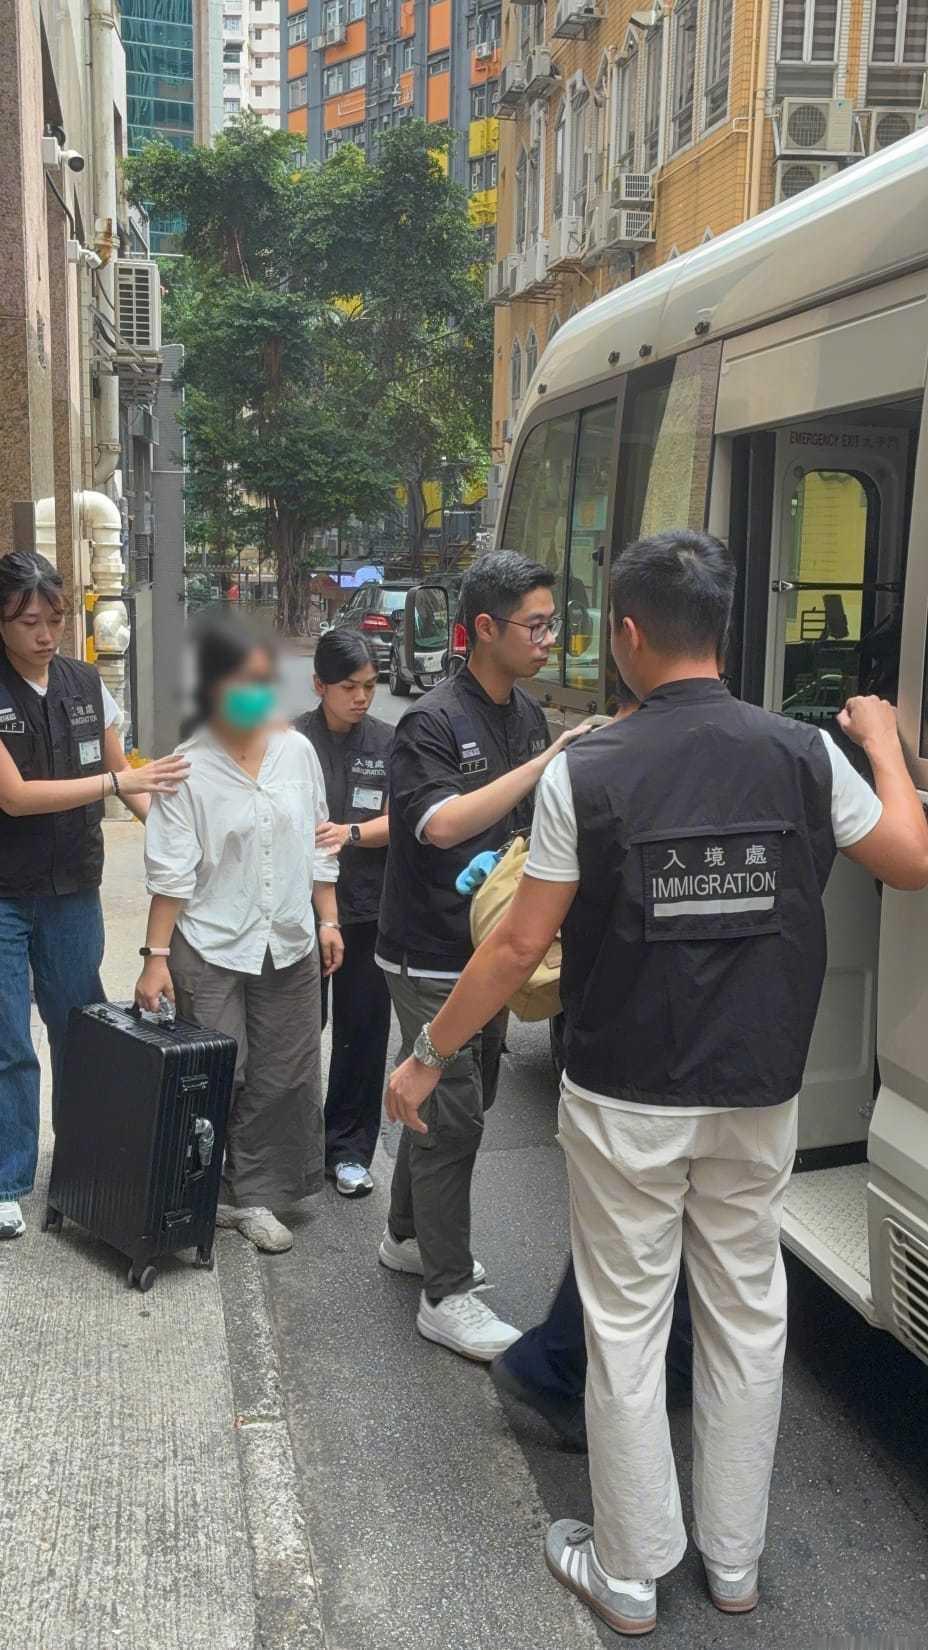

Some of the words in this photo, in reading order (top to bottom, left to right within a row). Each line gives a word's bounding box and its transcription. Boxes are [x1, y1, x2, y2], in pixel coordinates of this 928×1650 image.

[789, 431, 839, 447] EMERGENCY
[841, 434, 860, 448] EXIT
[663, 844, 768, 870] 入境處
[652, 871, 777, 898] IMMIGRATION
